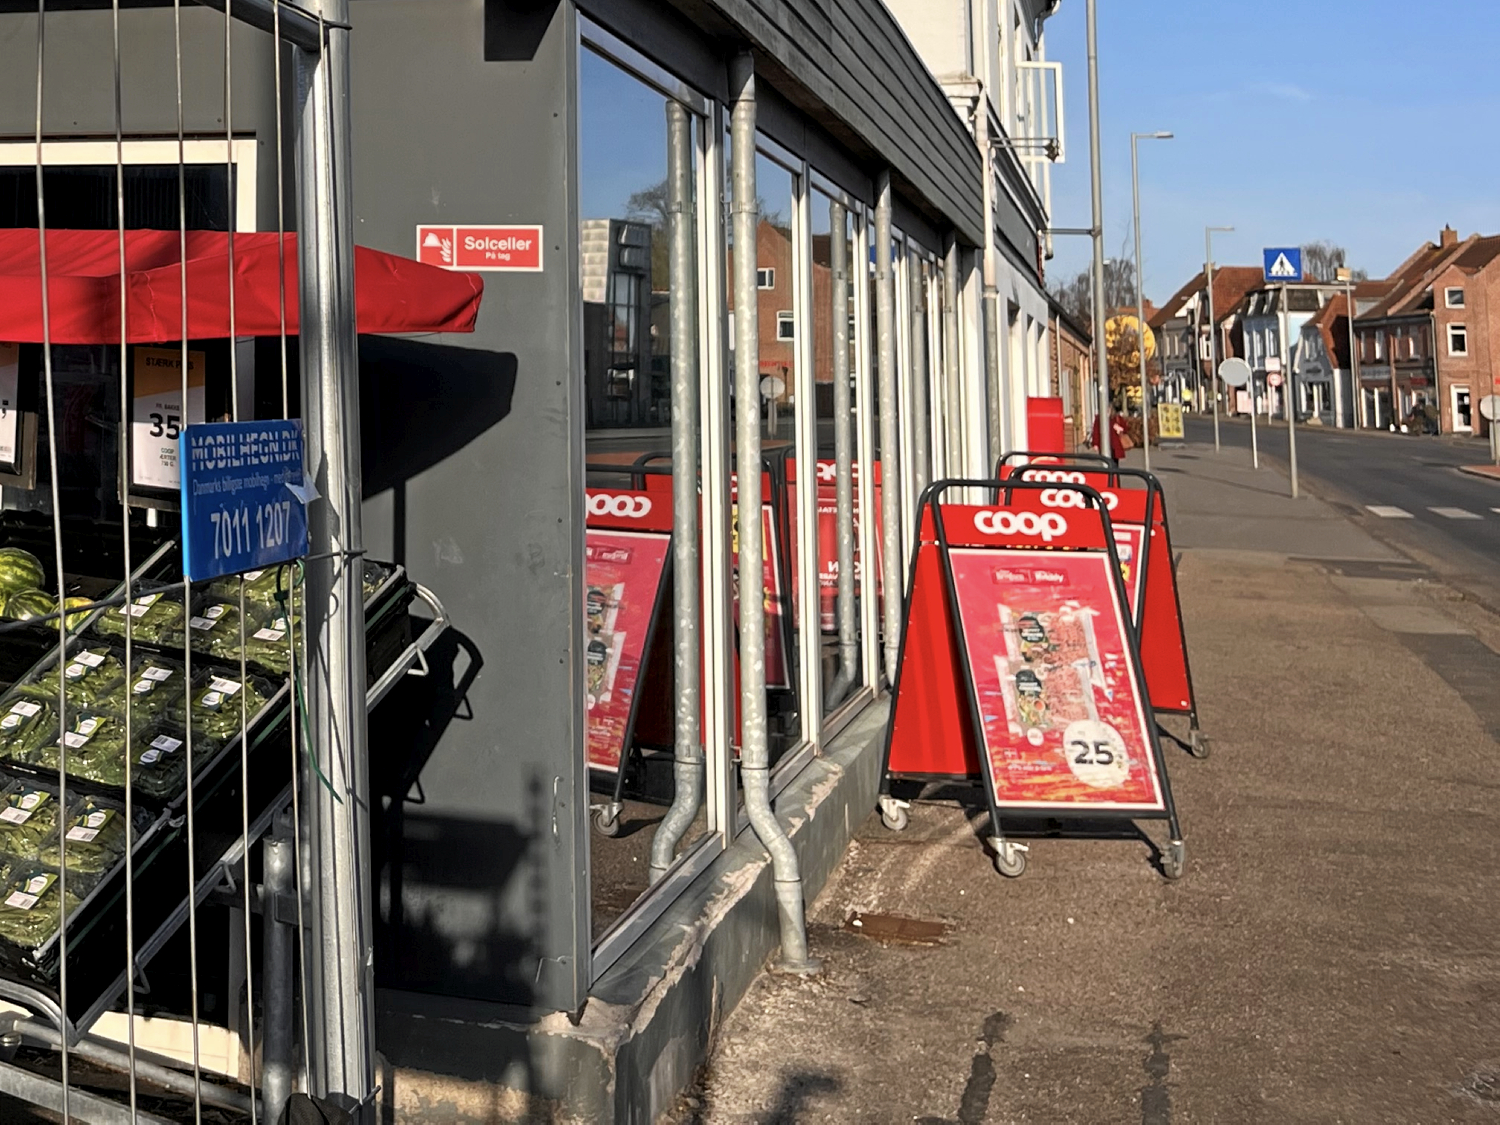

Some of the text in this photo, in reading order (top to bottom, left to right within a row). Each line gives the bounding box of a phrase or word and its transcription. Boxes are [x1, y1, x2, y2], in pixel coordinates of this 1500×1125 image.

[464, 236, 532, 251] Solceller
[485, 251, 511, 261] På tag
[146, 357, 194, 370] STÆRK PIS
[211, 501, 291, 560] 7011 1207
[974, 510, 1068, 542] coop
